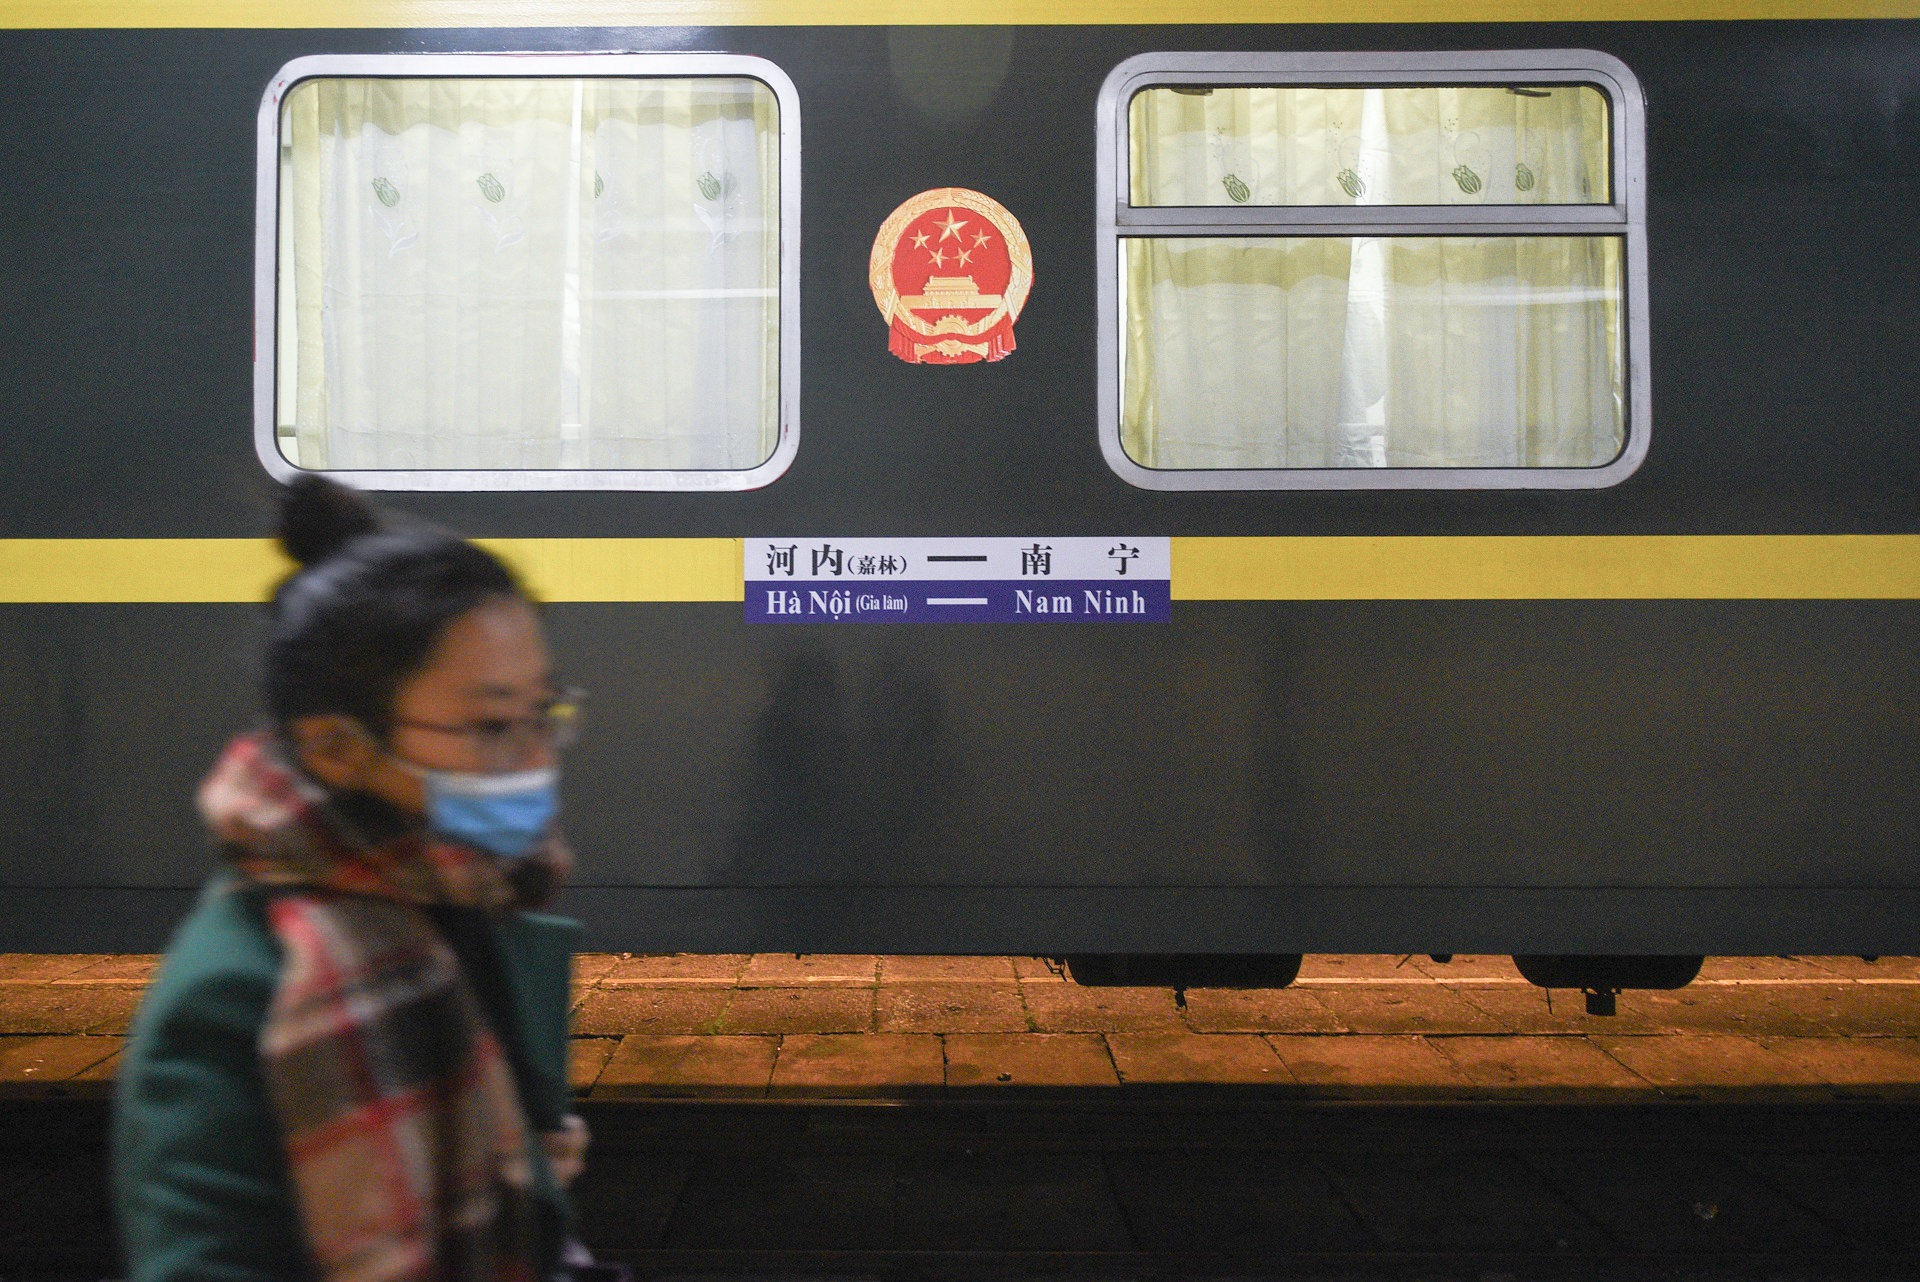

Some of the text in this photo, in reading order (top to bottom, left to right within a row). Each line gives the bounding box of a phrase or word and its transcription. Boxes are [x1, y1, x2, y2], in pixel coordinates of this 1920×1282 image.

[766, 588, 1146, 621] Hà Nội (Gia lâm) Nam Ninh
